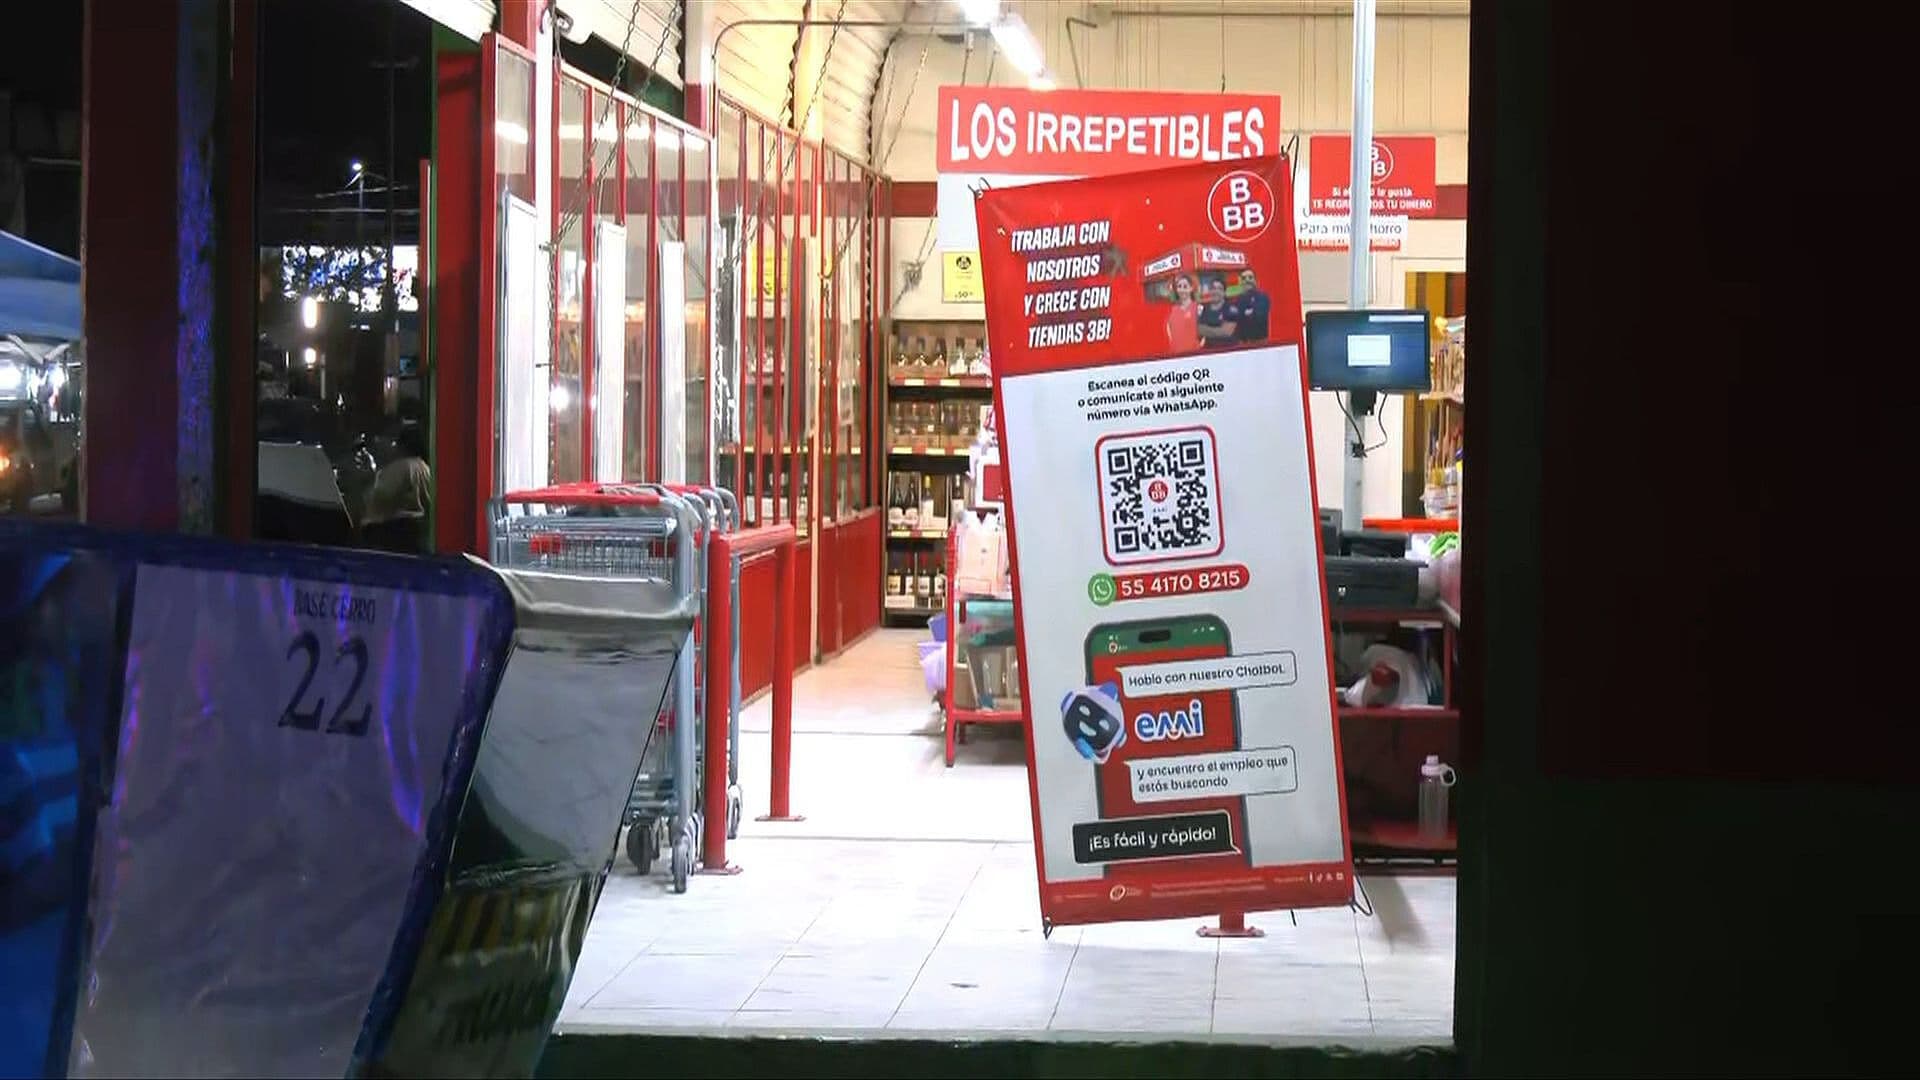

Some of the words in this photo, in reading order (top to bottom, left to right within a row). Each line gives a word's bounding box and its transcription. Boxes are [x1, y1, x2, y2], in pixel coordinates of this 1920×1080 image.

[950, 98, 1017, 161] LOS
[1027, 106, 1265, 160] IRREPETIBLES
[1222, 202, 1265, 232] BB
[1299, 223, 1329, 234] Para
[1369, 223, 1403, 234] horro
[1011, 224, 1076, 252] ¡TRABAJA
[1080, 220, 1110, 245] CON
[1027, 254, 1101, 283] NOSOTROS
[1024, 294, 1033, 317] Y
[1035, 290, 1078, 315] CRECE
[1080, 286, 1110, 310] CON
[1028, 322, 1084, 348] TIENDAS
[1087, 318, 1112, 342] 3B!
[1087, 378, 1135, 392] Escanea
[1137, 374, 1148, 386] el
[1150, 371, 1190, 385] código
[1192, 368, 1210, 381] QR
[1077, 400, 1085, 408] o
[1087, 391, 1155, 407] comunícate
[1157, 387, 1167, 398] al
[1170, 382, 1225, 398] siguiente
[1087, 407, 1131, 421] número
[1133, 405, 1151, 416] vía
[1152, 399, 1218, 415] WhatsApp.
[1121, 579, 1145, 596] 55
[1151, 575, 1193, 593] 4170
[1199, 570, 1241, 589] 8215
[278, 632, 373, 736] 22
[1164, 673, 1186, 685] con
[1189, 668, 1234, 682] nuestro
[1135, 700, 1204, 741] emi
[1137, 769, 1145, 781] y
[1147, 763, 1205, 778] encuentra
[1207, 761, 1218, 773] el
[1220, 757, 1263, 773] empleo
[1266, 756, 1288, 770] que
[1138, 778, 1169, 793] estás
[1171, 775, 1229, 790] buscando
[1088, 836, 1111, 852] ¡Es
[1113, 831, 1146, 847] fácil
[1149, 834, 1158, 848] y
[1162, 827, 1217, 845] rápido!
